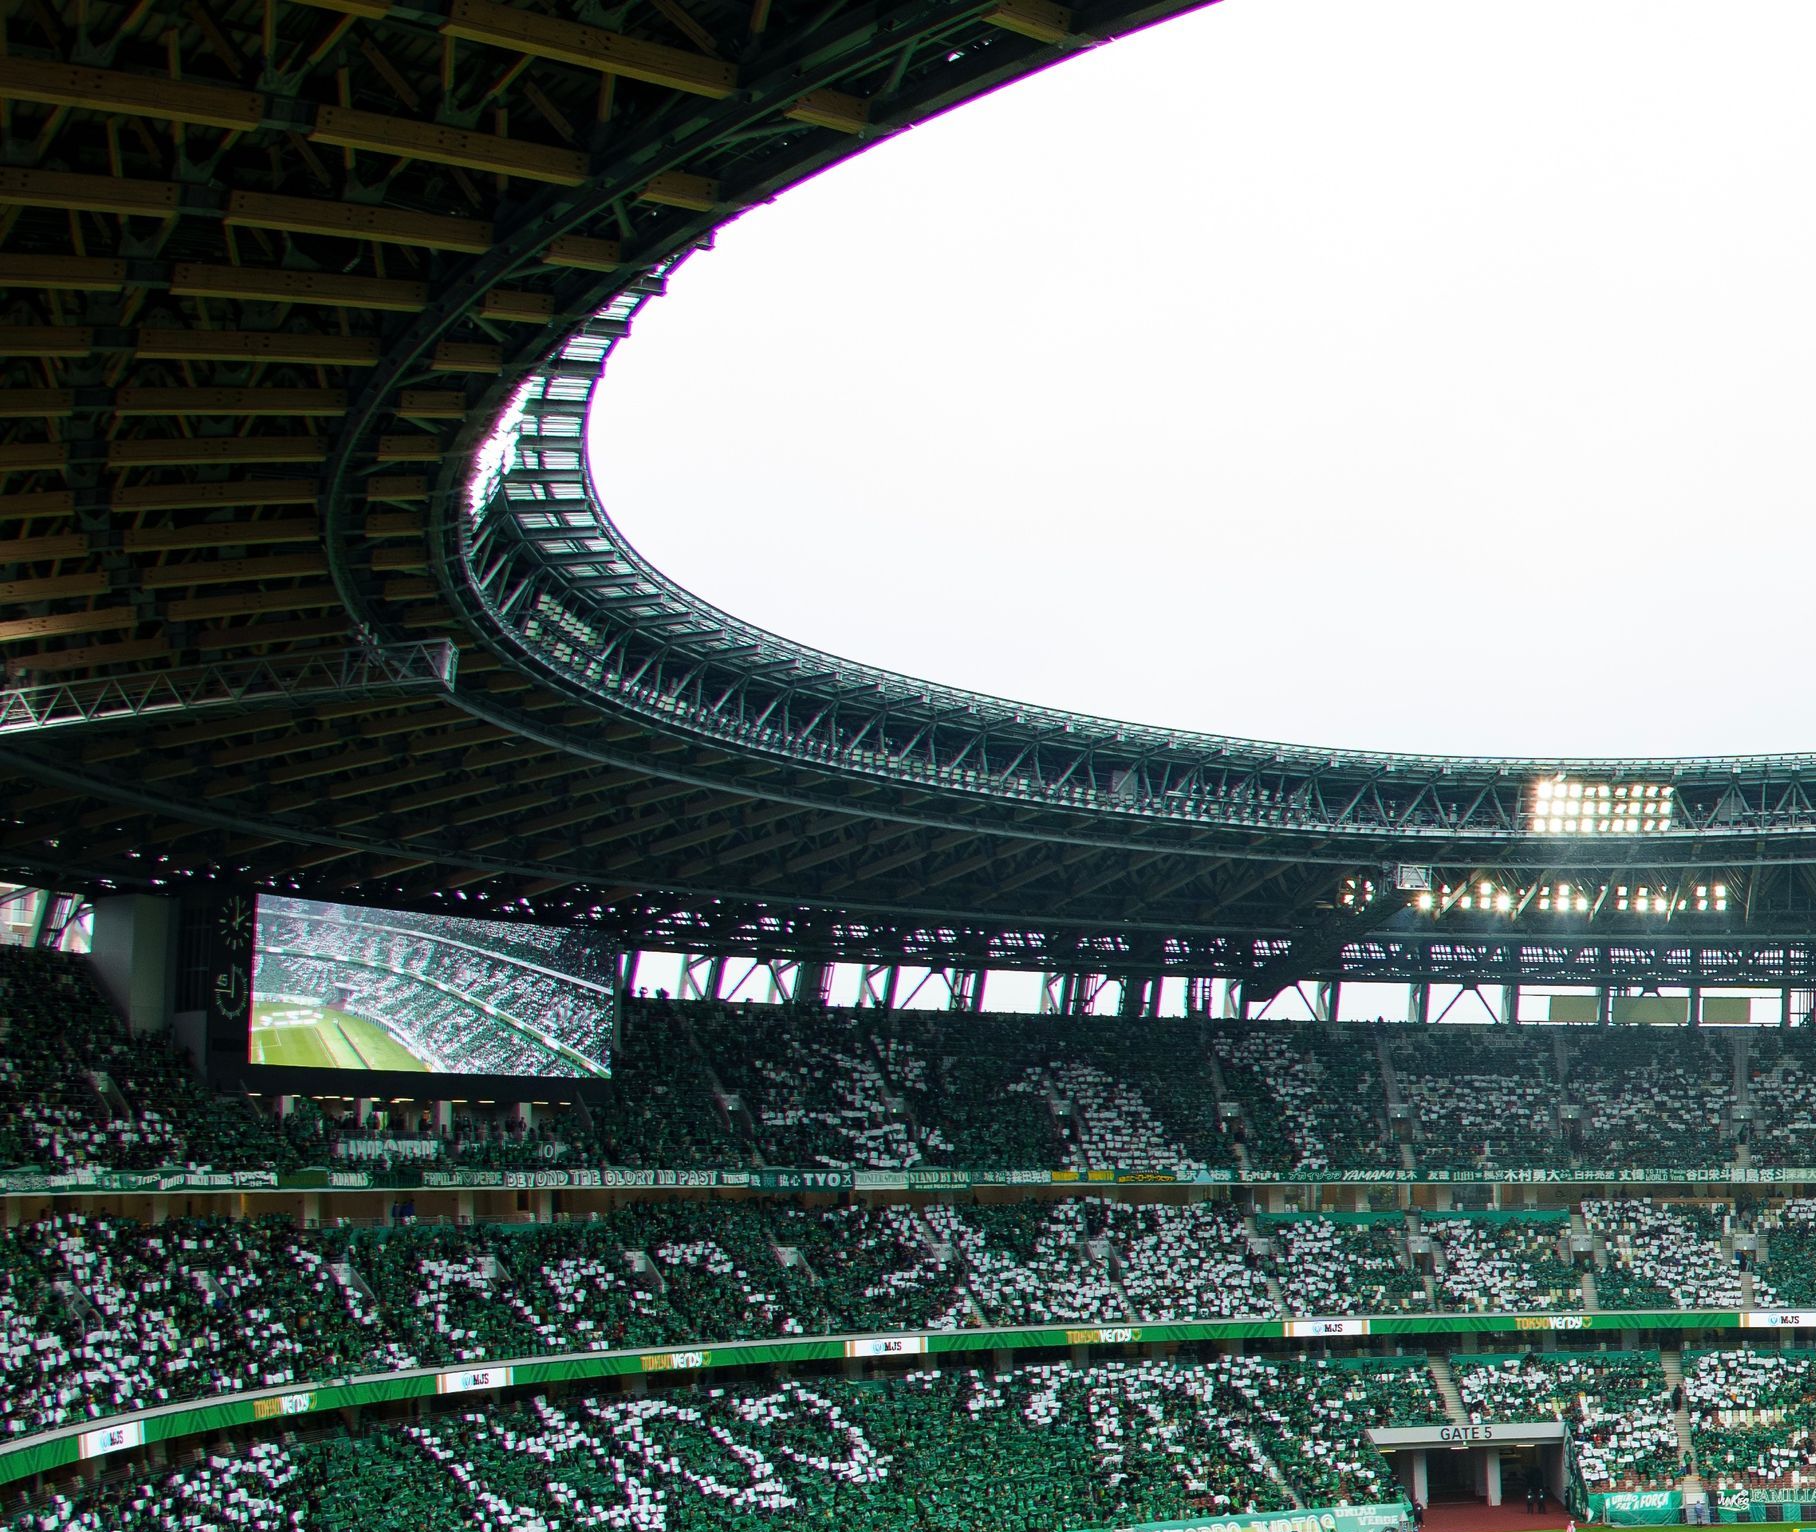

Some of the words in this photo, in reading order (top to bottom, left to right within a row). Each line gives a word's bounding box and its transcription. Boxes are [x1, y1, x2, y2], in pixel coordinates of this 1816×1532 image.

[507, 1171, 567, 1188] BEYOND
[571, 1171, 601, 1187] THE
[605, 1170, 655, 1186] GLORY
[659, 1170, 676, 1186] IN
[678, 1170, 718, 1186] PAST
[1781, 1315, 1800, 1326] MJS
[1324, 1322, 1343, 1333] MJS
[884, 1341, 902, 1354] MJS
[473, 1373, 490, 1388] MJS
[1441, 1428, 1480, 1441] GATE
[1485, 1427, 1493, 1439] 5
